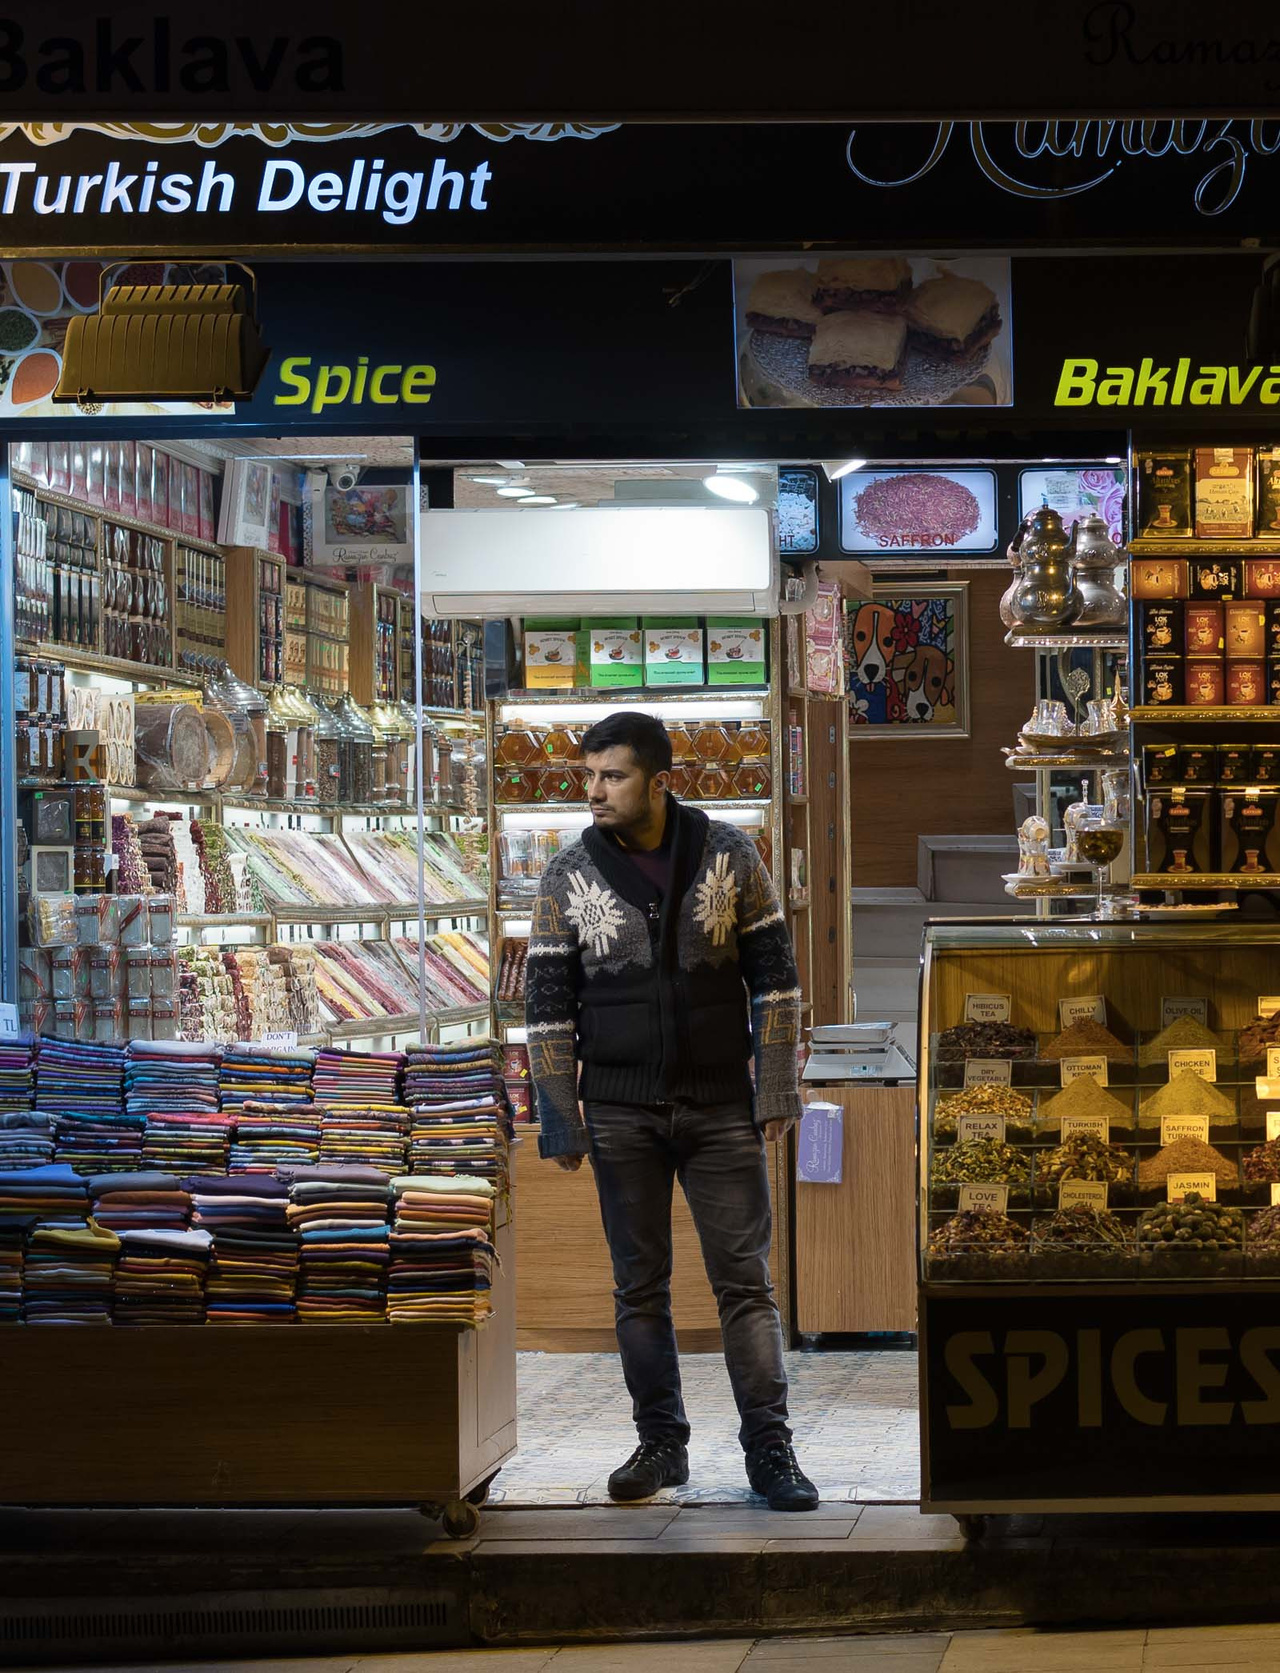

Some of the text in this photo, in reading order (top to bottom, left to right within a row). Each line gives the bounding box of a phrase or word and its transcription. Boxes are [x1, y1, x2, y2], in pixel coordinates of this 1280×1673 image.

[0, 157, 493, 225] Turkish Delight
[274, 357, 438, 415] Spice
[879, 533, 955, 548] SAFFRON
[972, 1003, 1005, 1011] HIBICUS
[1069, 1006, 1097, 1016] CHILLY
[1189, 1006, 1204, 1015] OIL
[980, 1010, 996, 1018] TEA
[4, 1018, 18, 1032] TL
[266, 1032, 291, 1041] DON'T
[1066, 1063, 1102, 1072] OTTOMAN
[1174, 1060, 1210, 1068] CHICKEN
[980, 1068, 995, 1076] DRY
[967, 1074, 1008, 1083] VEGETABLE
[965, 1122, 998, 1131] RELAX
[1067, 1121, 1103, 1129] TURKISH
[1165, 1124, 1204, 1133] SAFFRON
[1173, 1182, 1210, 1190] JASMIN
[969, 1192, 998, 1201] LOVE
[1062, 1192, 1105, 1200] CHOLESTEROL
